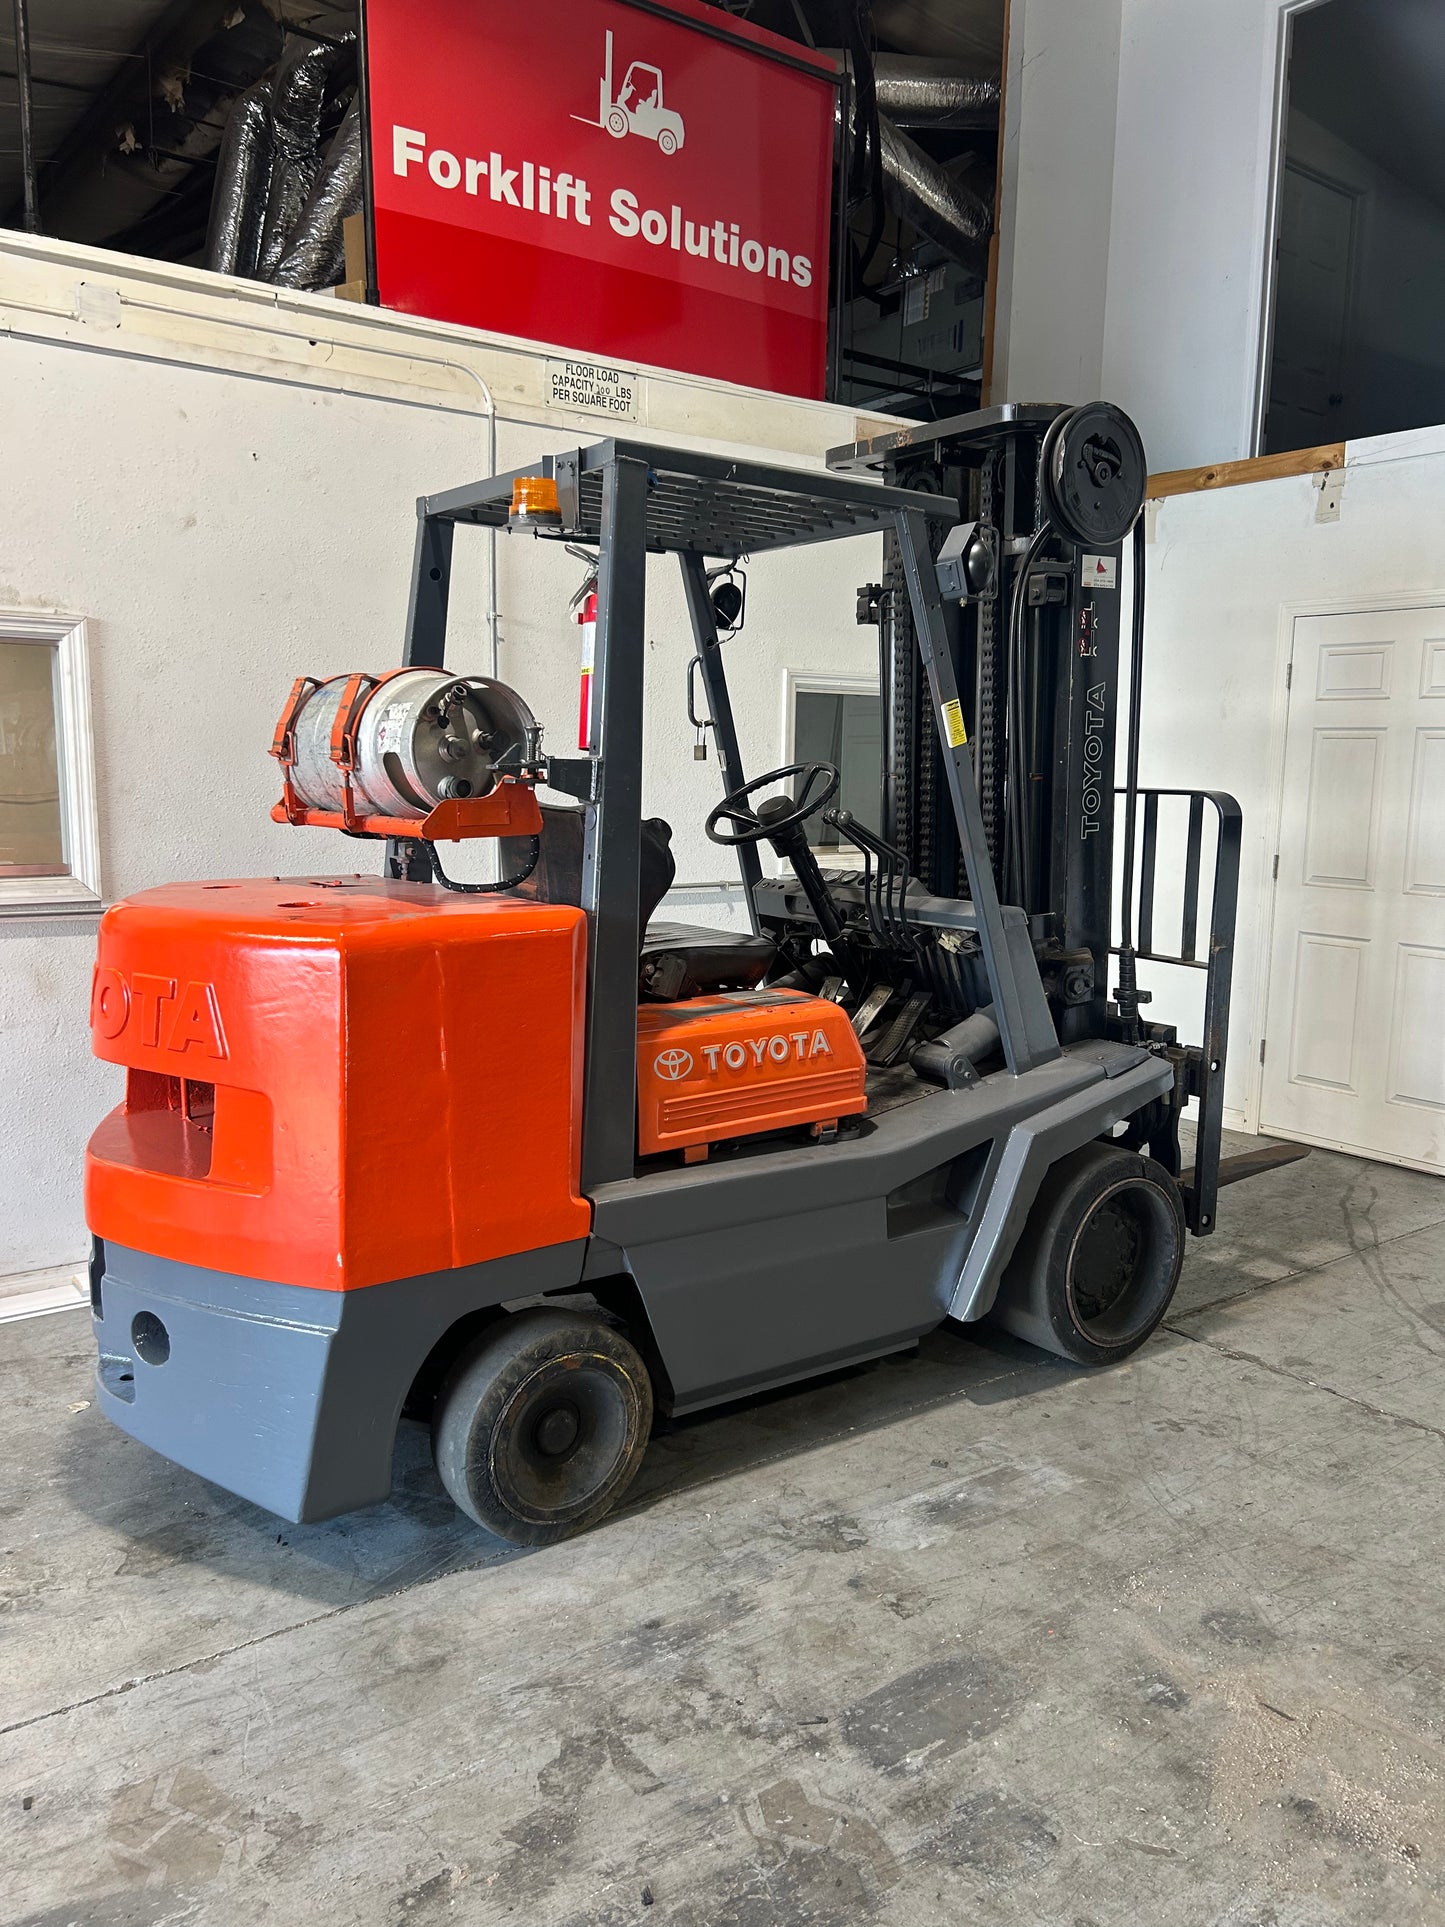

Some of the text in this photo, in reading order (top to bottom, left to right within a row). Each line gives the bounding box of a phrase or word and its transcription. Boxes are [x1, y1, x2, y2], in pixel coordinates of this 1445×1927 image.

[393, 125, 812, 288] Forklift Solutions
[552, 374, 594, 391] CAPACITY
[616, 386, 632, 399] LBS
[566, 364, 619, 384] FLOOR LOAD
[553, 388, 570, 401] PER
[572, 391, 608, 408] SQUARE
[609, 398, 631, 412] FOOT
[1081, 682, 1106, 840] TOYOTA
[90, 964, 230, 1061] OTA
[701, 1029, 832, 1072] TOYOTA
